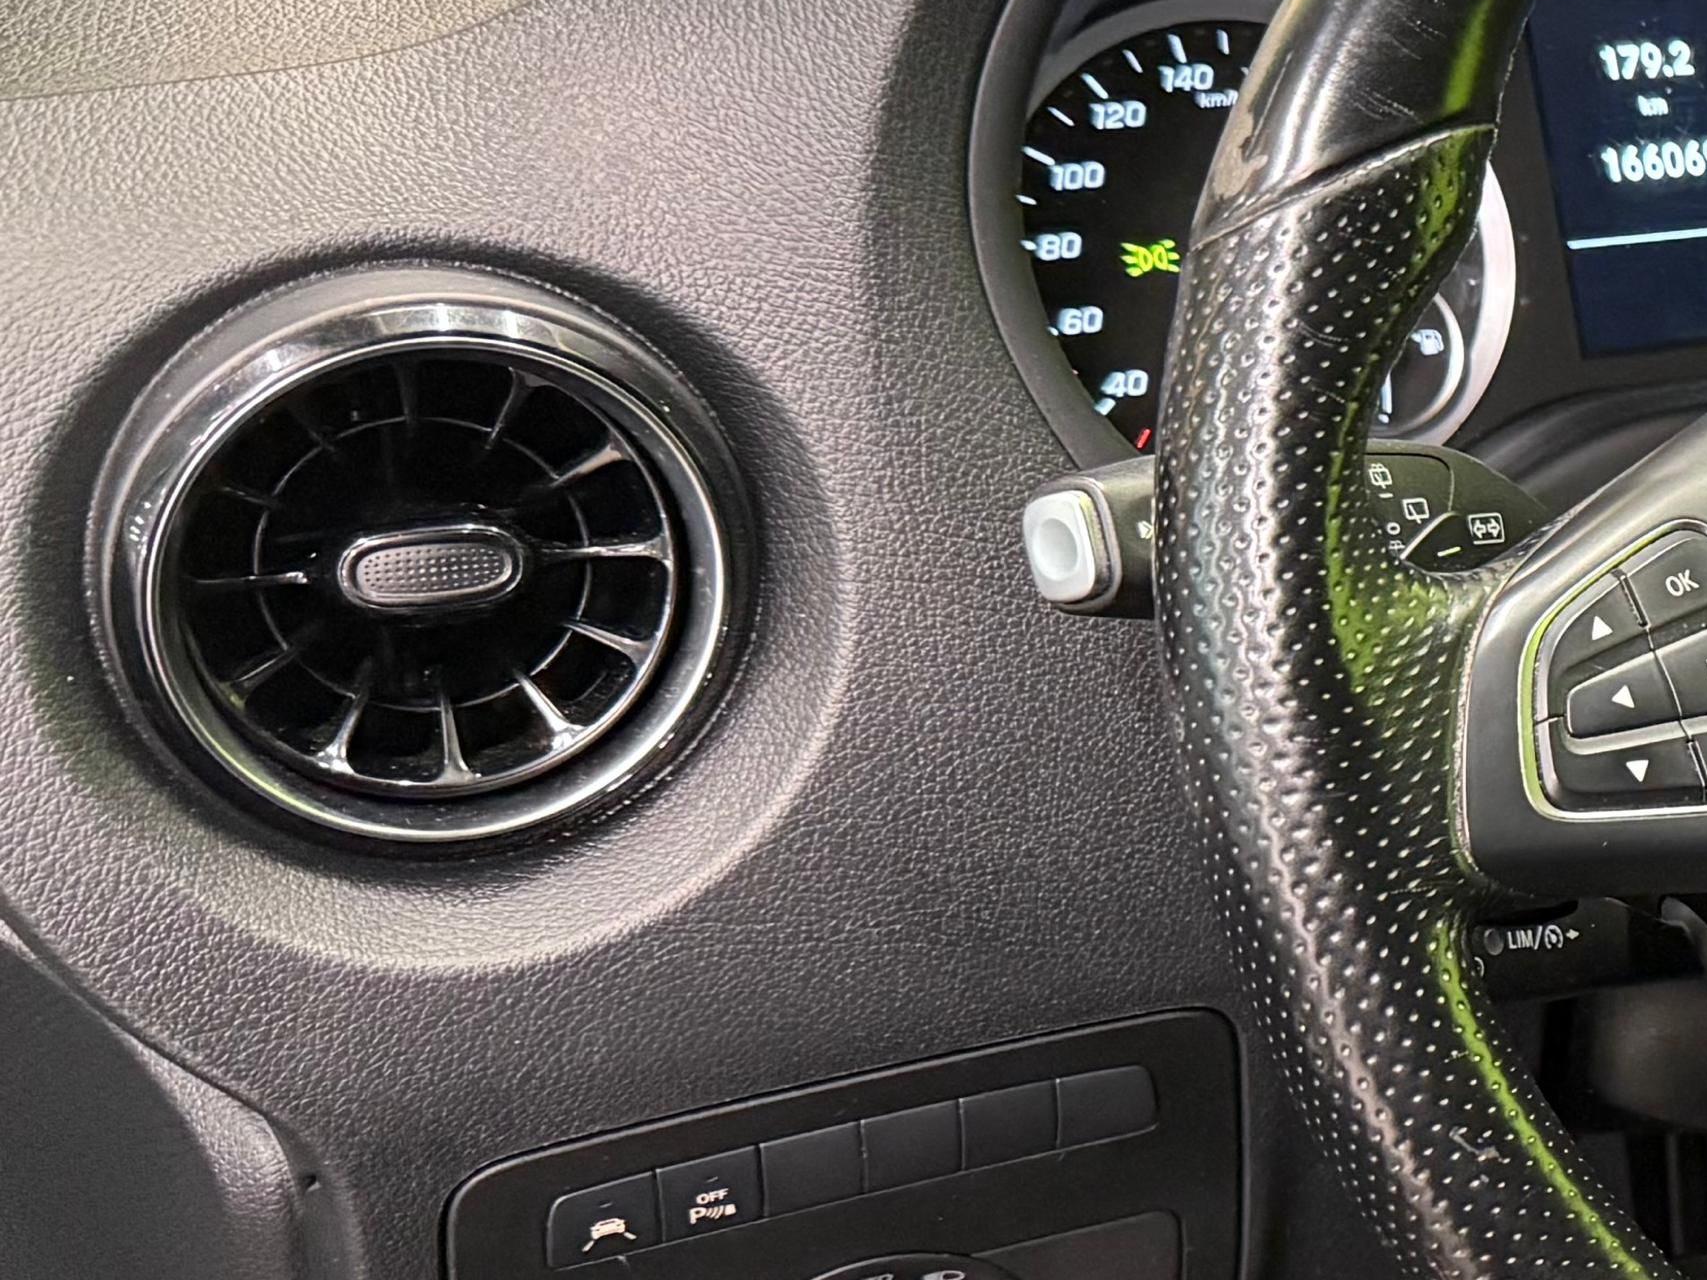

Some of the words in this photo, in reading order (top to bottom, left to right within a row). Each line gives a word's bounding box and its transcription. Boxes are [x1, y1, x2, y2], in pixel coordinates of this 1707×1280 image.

[1599, 40, 1696, 81] 179.2
[1158, 64, 1215, 93] 140
[1089, 100, 1147, 130] 120
[1637, 95, 1669, 117] km
[1050, 161, 1105, 191] 100
[1035, 231, 1083, 261] 80
[1057, 306, 1104, 335] 60
[1101, 369, 1149, 398] 40
[1665, 568, 1700, 597] OK
[696, 1187, 729, 1205] OFF
